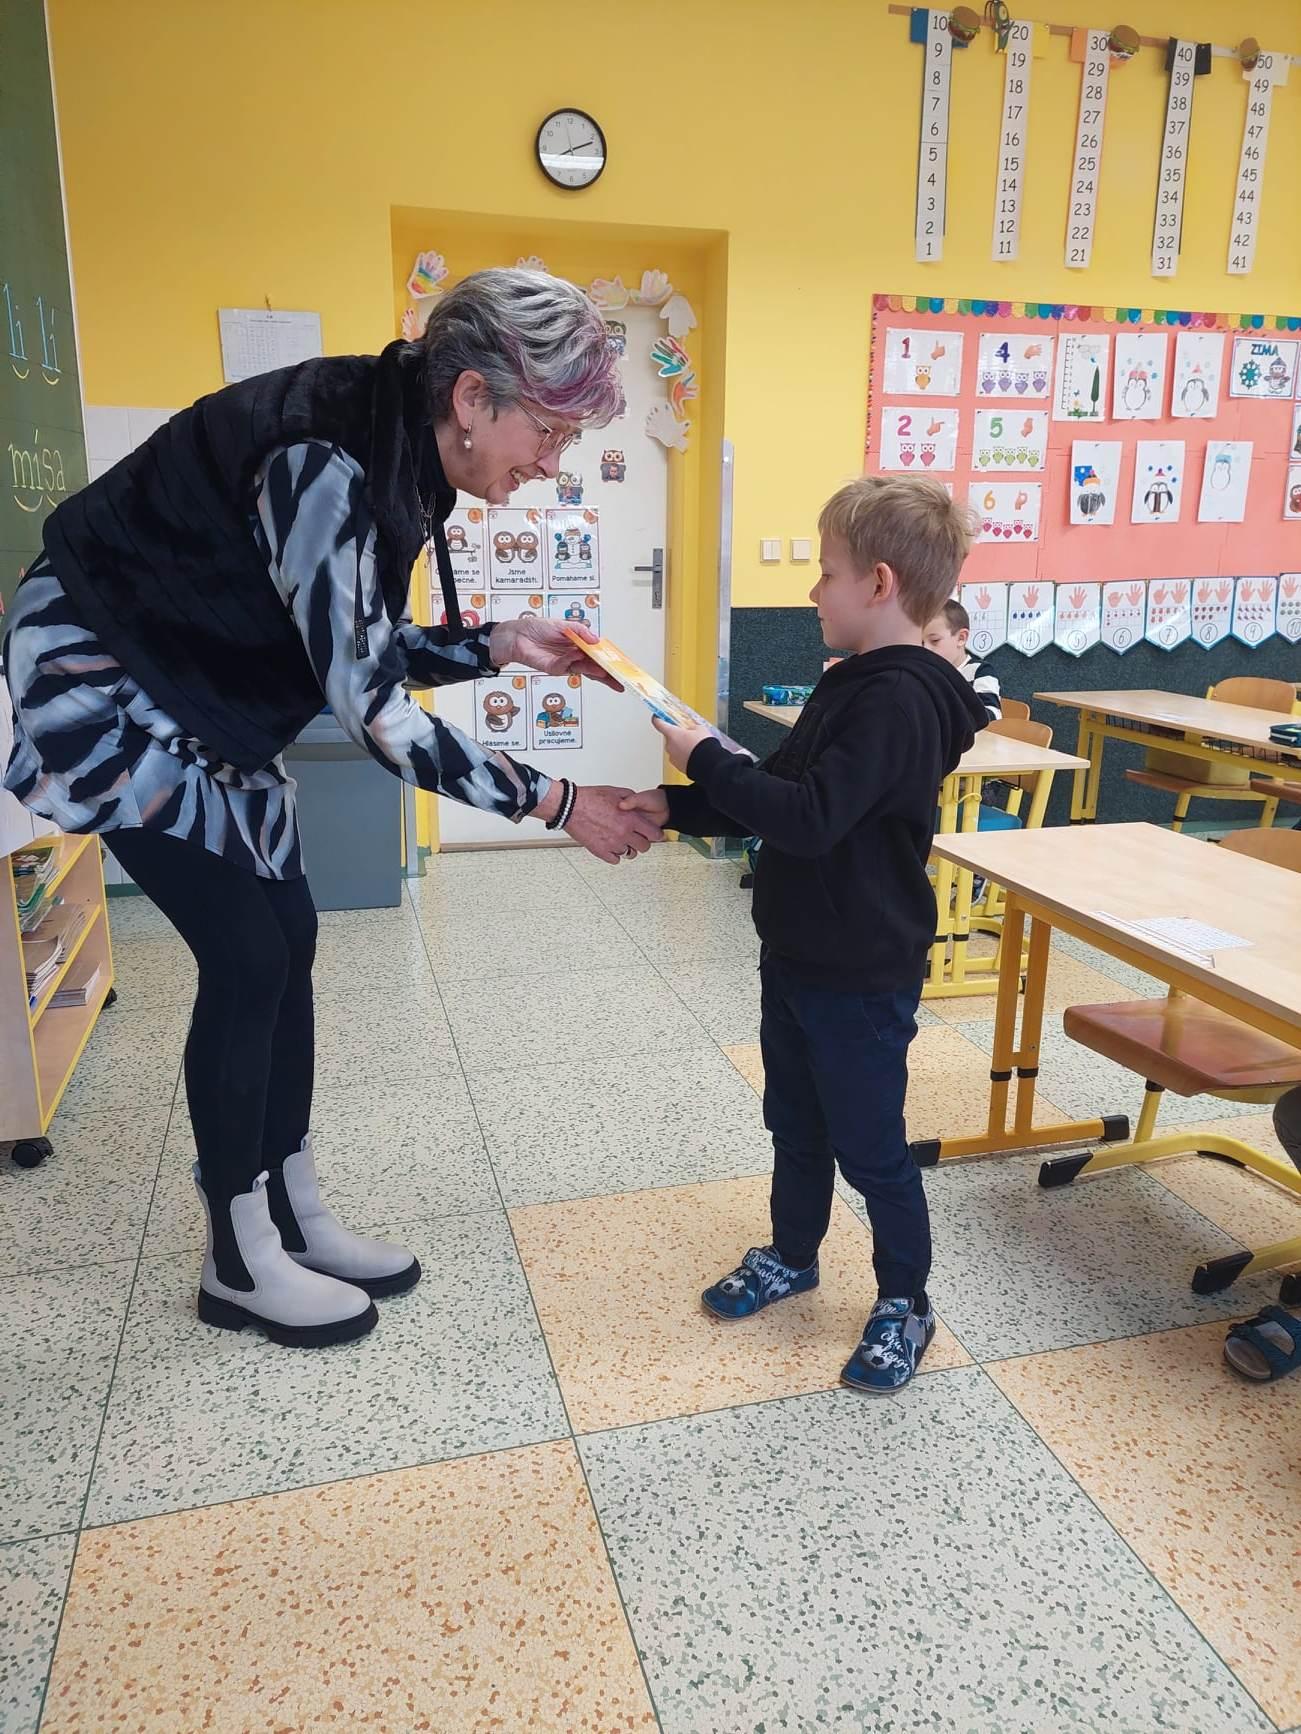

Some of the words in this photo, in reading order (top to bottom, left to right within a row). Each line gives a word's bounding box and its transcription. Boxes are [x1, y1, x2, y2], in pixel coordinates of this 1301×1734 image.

[934, 16, 947, 30] 10
[1011, 25, 1028, 40] 20
[935, 43, 942, 57] 9
[1091, 36, 1108, 51] 30
[1012, 53, 1025, 67] 19
[1178, 48, 1192, 61] 40
[1257, 54, 1272, 69] 50
[1088, 63, 1104, 76] 29
[933, 71, 940, 85] 8
[1175, 72, 1189, 86] 39
[1010, 80, 1022, 93] 18
[1255, 79, 1269, 92] 49
[1087, 85, 1102, 100] 28
[933, 97, 940, 111] 7
[1172, 97, 1186, 110] 38
[1251, 103, 1264, 116] 48
[1008, 106, 1022, 119] 17
[1084, 110, 1100, 124] 27
[931, 122, 938, 136] 6
[1169, 121, 1185, 134] 37
[1248, 126, 1263, 138] 47
[1006, 133, 1019, 146] 16
[1081, 135, 1097, 148] 26
[929, 148, 937, 161] 5
[1167, 146, 1181, 158] 36
[1245, 147, 1259, 160] 46
[1005, 158, 1018, 171] 15
[1079, 157, 1095, 170] 25
[927, 173, 936, 186] 4
[1165, 169, 1180, 181] 35
[1242, 168, 1256, 181] 45
[1003, 179, 1016, 191] 14
[1077, 181, 1093, 193] 24
[1163, 191, 1177, 203] 34
[1240, 190, 1253, 201] 44
[928, 197, 934, 210] 3
[1002, 200, 1015, 212] 13
[1075, 203, 1090, 216] 23
[1160, 214, 1176, 227] 33
[1237, 212, 1251, 224] 43
[926, 221, 933, 234] 2
[1000, 220, 1014, 233] 12
[1072, 227, 1089, 239] 22
[1000, 241, 1010, 253] 11
[1158, 236, 1174, 248] 32
[1234, 235, 1249, 246] 42
[1071, 249, 1084, 261] 21
[1158, 257, 1171, 269] 31
[1233, 256, 1245, 268] 41
[901, 337, 911, 359] 1
[995, 341, 1010, 363] 4
[1251, 343, 1279, 356] ZIMA
[897, 415, 912, 436] 2
[990, 417, 1003, 438] 5
[8, 428, 66, 492] mísa
[984, 490, 996, 511] 6
